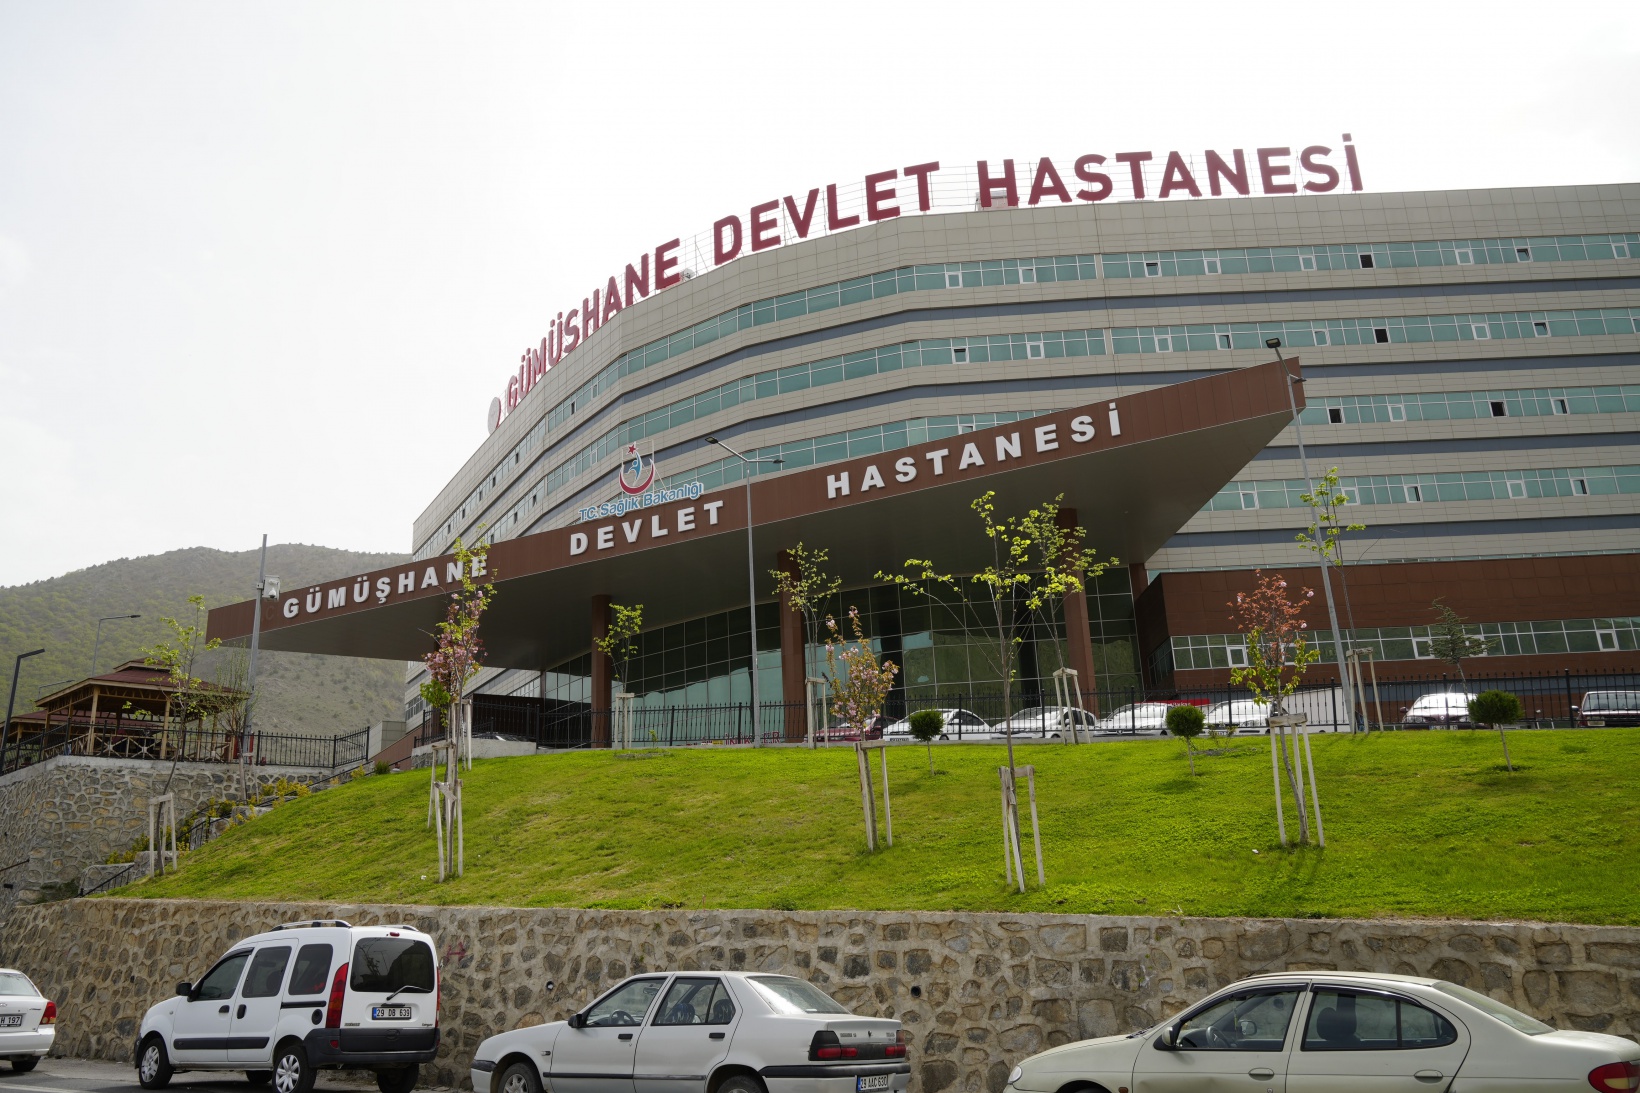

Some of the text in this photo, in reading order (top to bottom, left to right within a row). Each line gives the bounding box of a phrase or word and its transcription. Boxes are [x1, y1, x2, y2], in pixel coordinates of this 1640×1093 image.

[713, 160, 940, 267] DEVLET
[976, 132, 1364, 209] HASTANESİ
[282, 401, 1122, 620] GÜMÜŞHANE DEVLET HASTANESİ
[600, 496, 640, 517] Sağlık
[643, 481, 704, 507] Bakanlığı
[376, 1008, 385, 1017] 29
